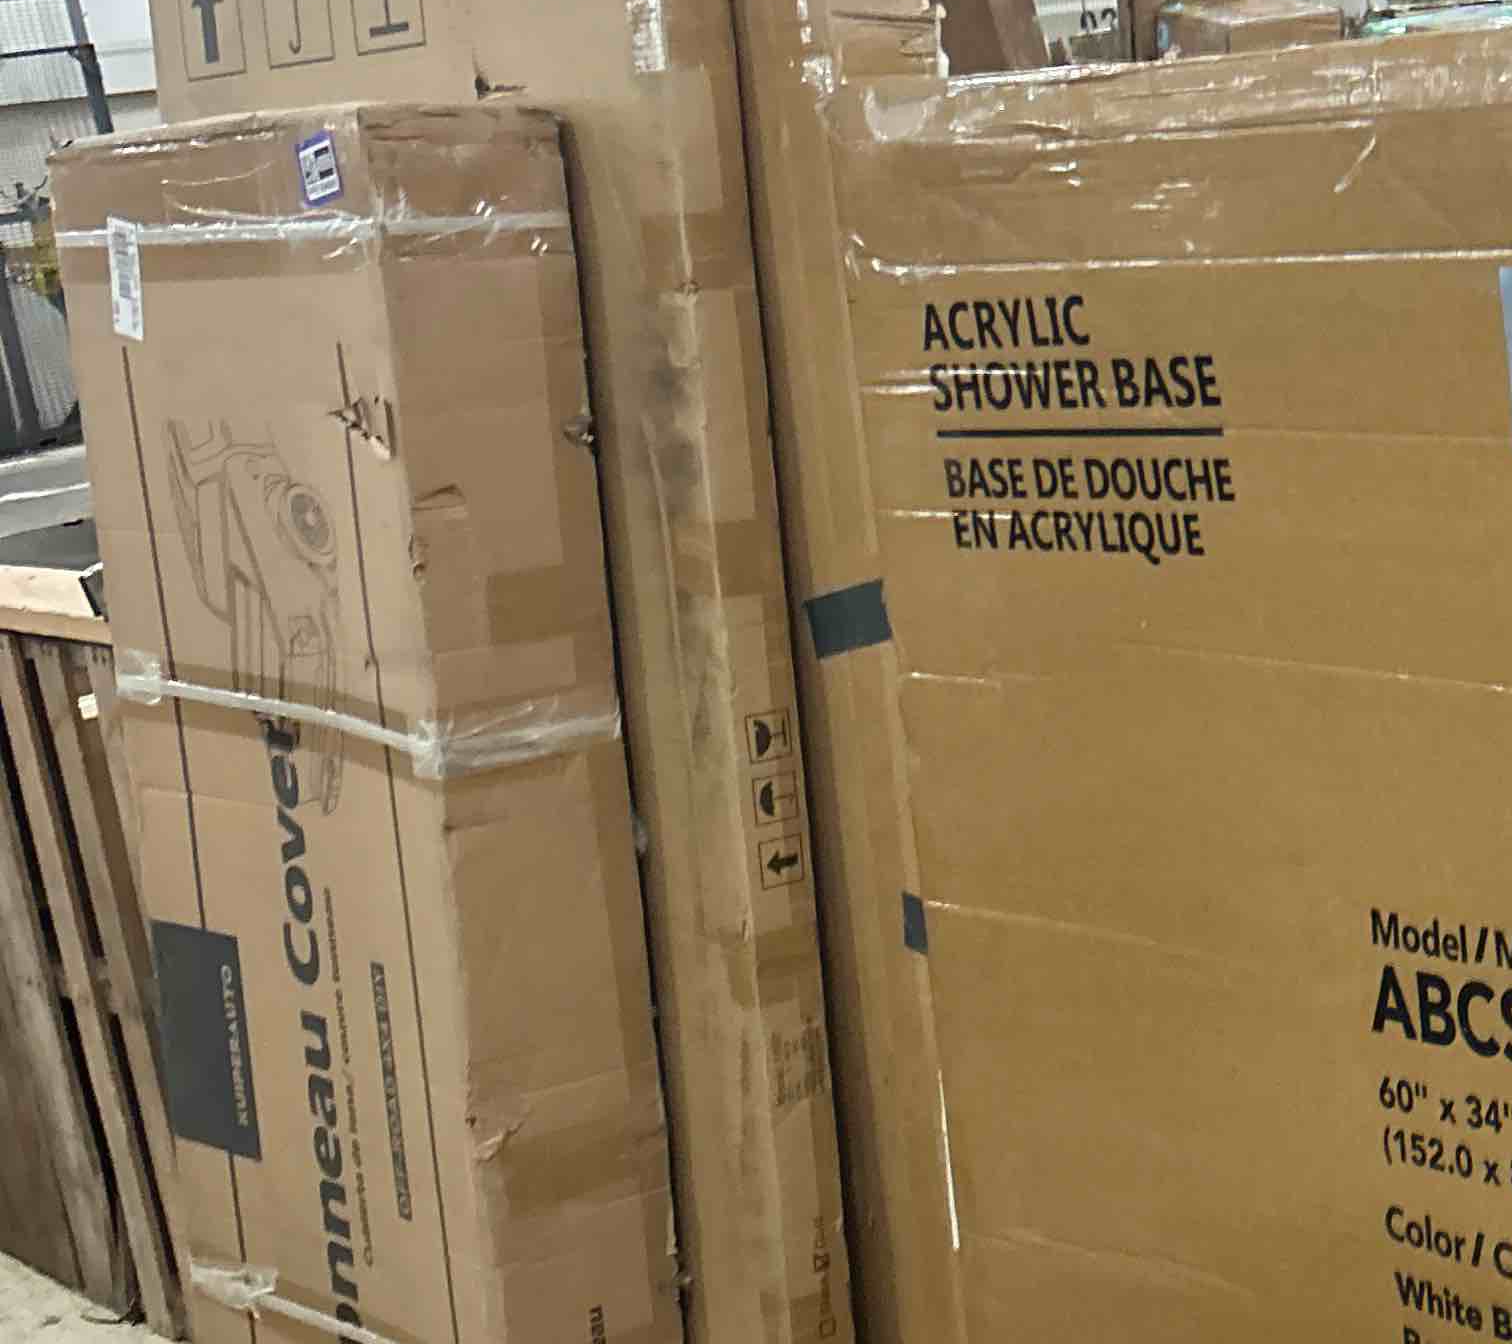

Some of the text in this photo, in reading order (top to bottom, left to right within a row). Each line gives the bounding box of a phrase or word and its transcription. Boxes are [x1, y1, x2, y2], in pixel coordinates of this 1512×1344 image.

[923, 295, 1091, 351] ACRYLIC
[929, 355, 1222, 412] SHOWER BASE
[945, 458, 1236, 502] BASE DE DOUCHE
[953, 509, 1205, 566] EN ACRYLIQUE
[264, 718, 321, 987] Cover
[1370, 908, 1468, 963] Model
[1379, 1076, 1428, 1114] 60"
[1440, 1095, 1456, 1125] x
[1383, 1126, 1473, 1179] (152.0
[1482, 1157, 1501, 1187] x
[1386, 1205, 1467, 1265] Color
[1395, 1271, 1482, 1331] White
